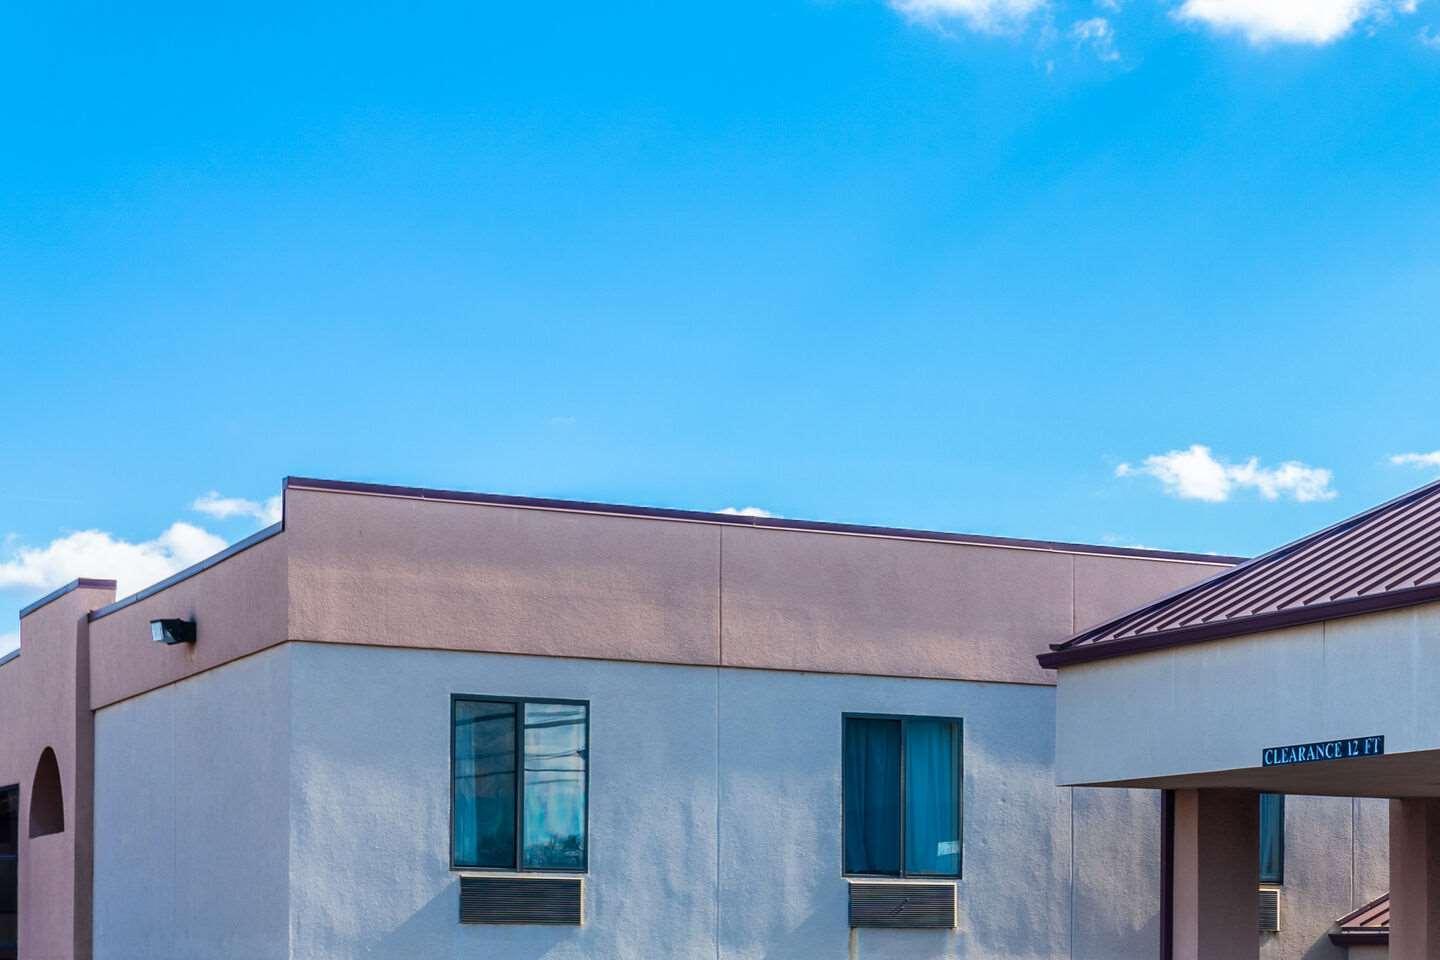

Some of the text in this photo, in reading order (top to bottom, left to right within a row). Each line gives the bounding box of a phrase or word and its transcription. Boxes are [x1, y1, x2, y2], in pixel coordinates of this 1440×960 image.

[1264, 736, 1381, 765] CLEARANCE 12 FT
